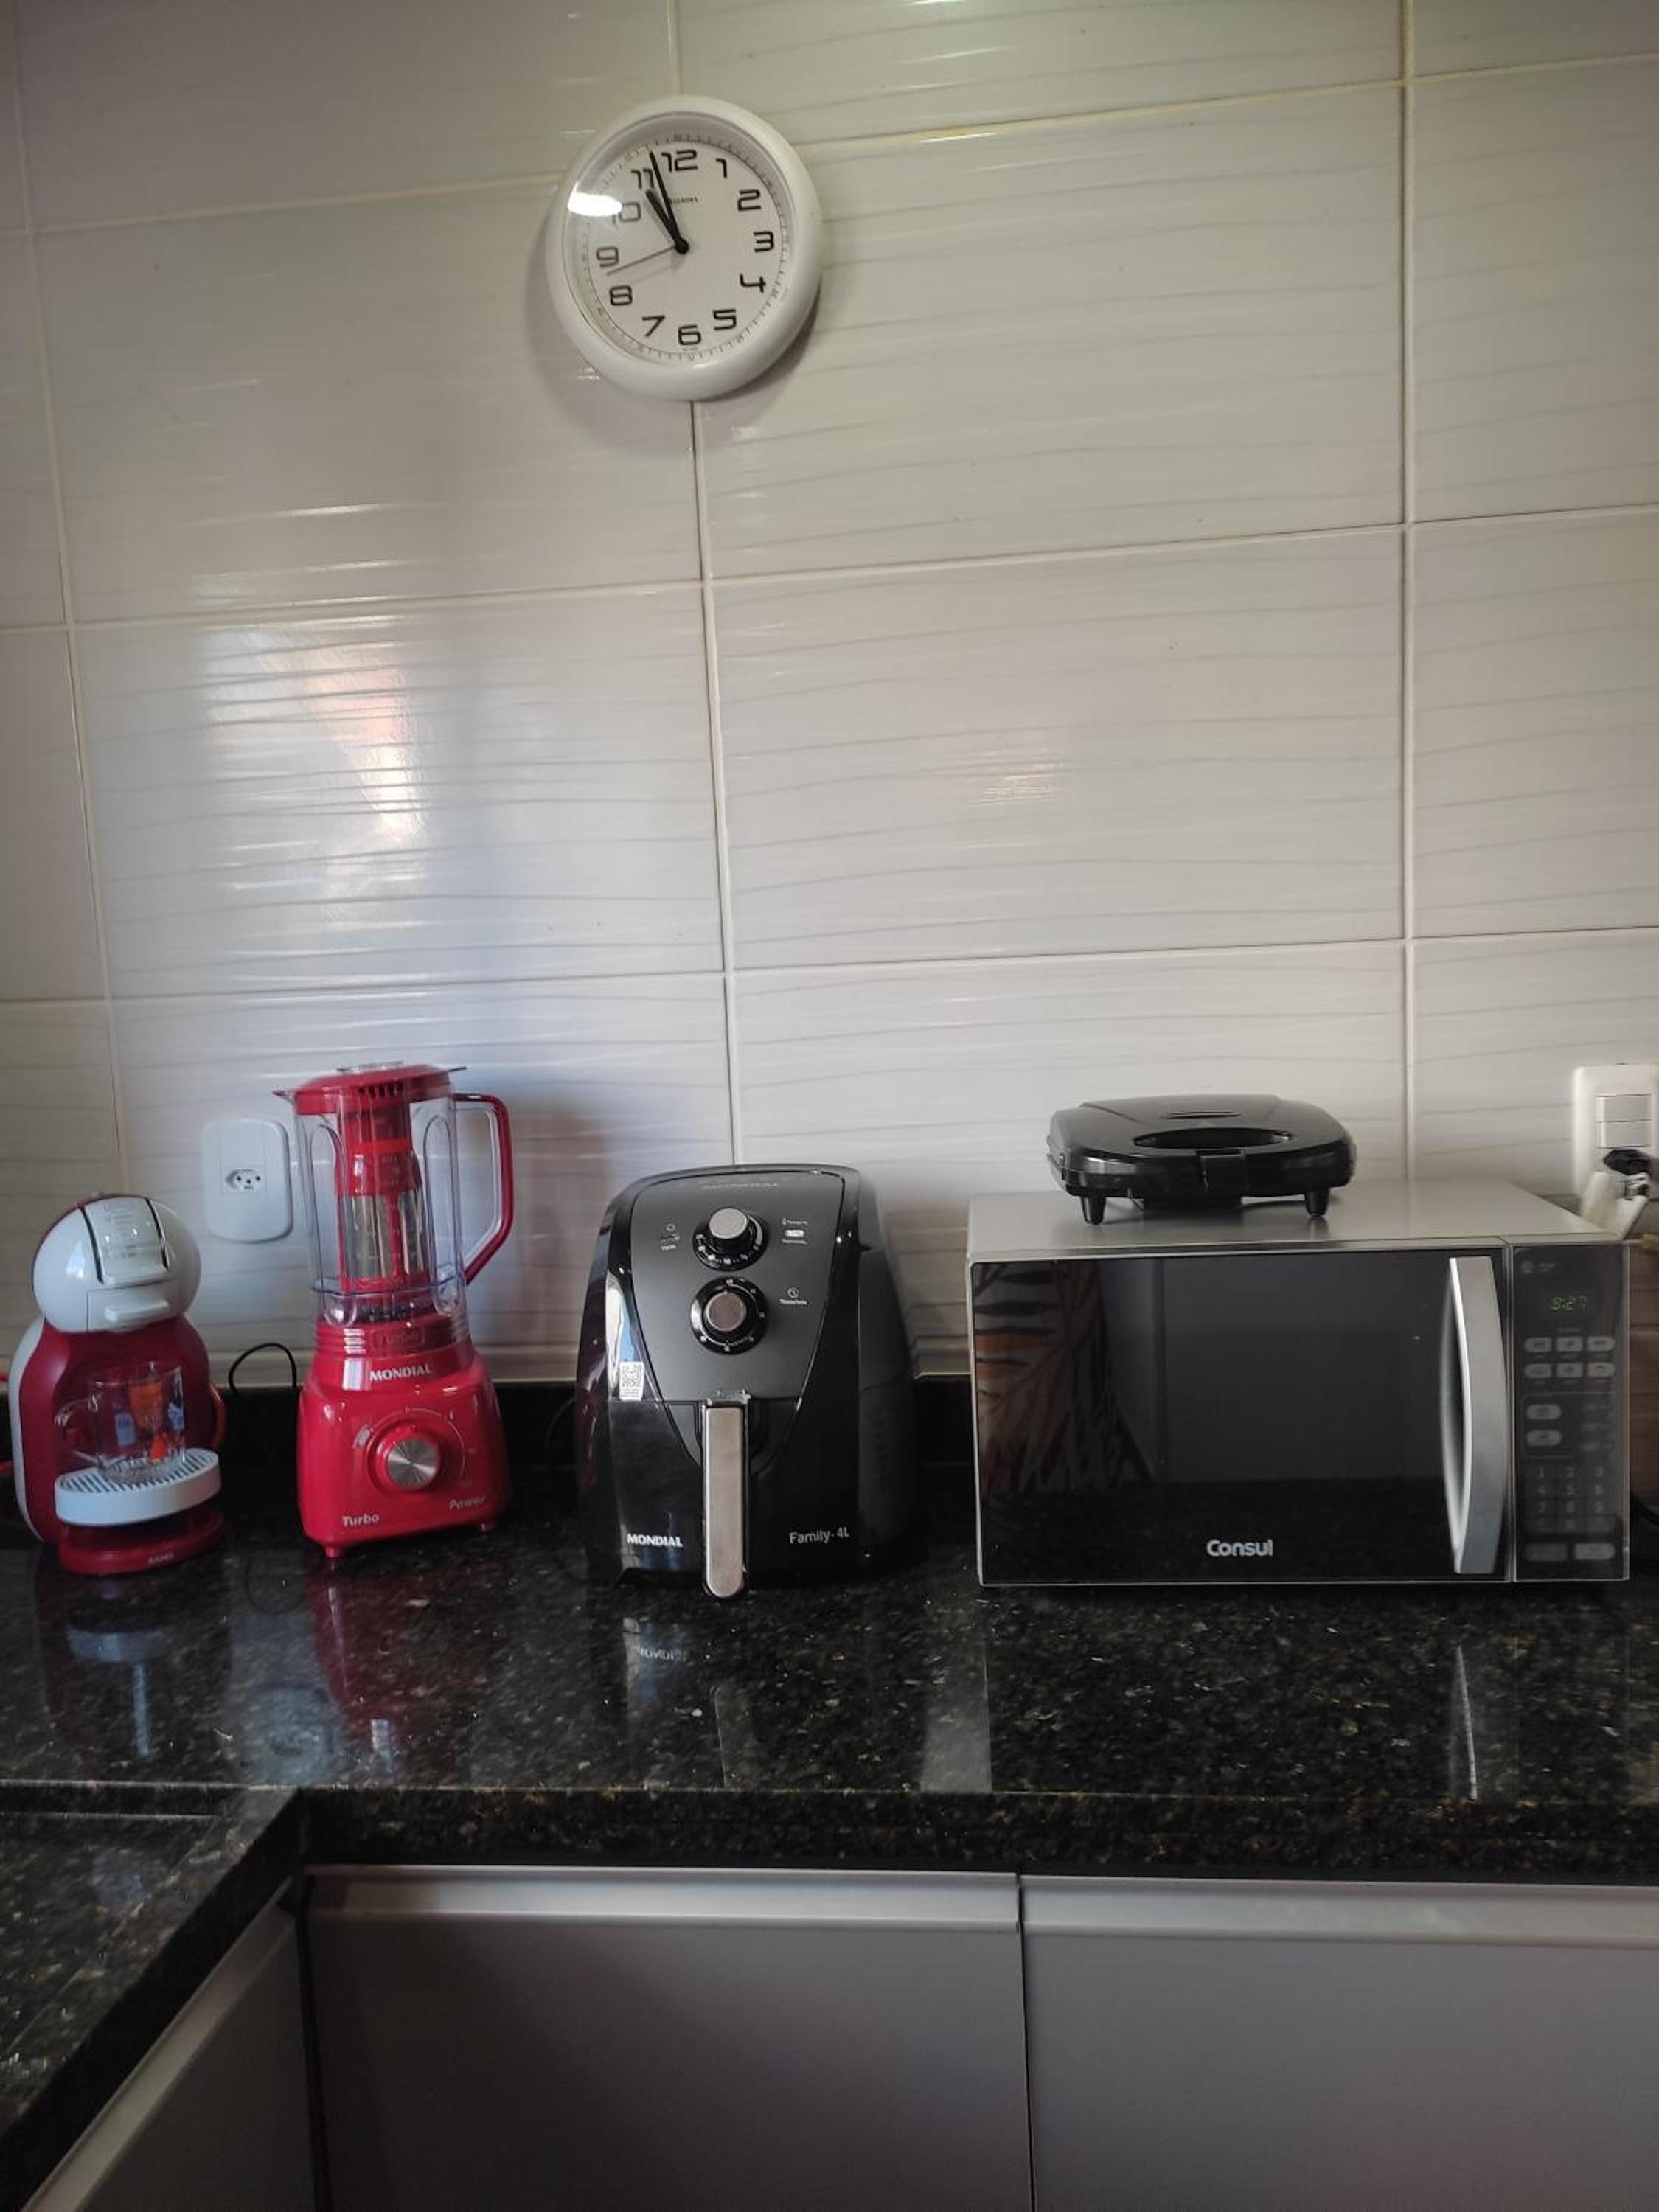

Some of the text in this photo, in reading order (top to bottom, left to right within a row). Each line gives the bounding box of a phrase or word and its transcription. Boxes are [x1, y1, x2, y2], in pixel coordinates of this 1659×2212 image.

[661, 149, 698, 172] 12
[716, 158, 728, 178] 1
[631, 169, 655, 189] 11
[738, 189, 762, 211] 2
[753, 231, 774, 252] 3
[596, 246, 619, 268] 9
[740, 274, 766, 293] 4
[609, 285, 633, 306] 8
[642, 316, 665, 337] 7
[713, 309, 737, 330] 5
[678, 324, 701, 346] 6
[369, 1364, 431, 1382] MONDIAL
[342, 1513, 379, 1526] Turbo
[627, 1533, 683, 1548] MONDIAL
[1206, 1539, 1273, 1557] Consul
